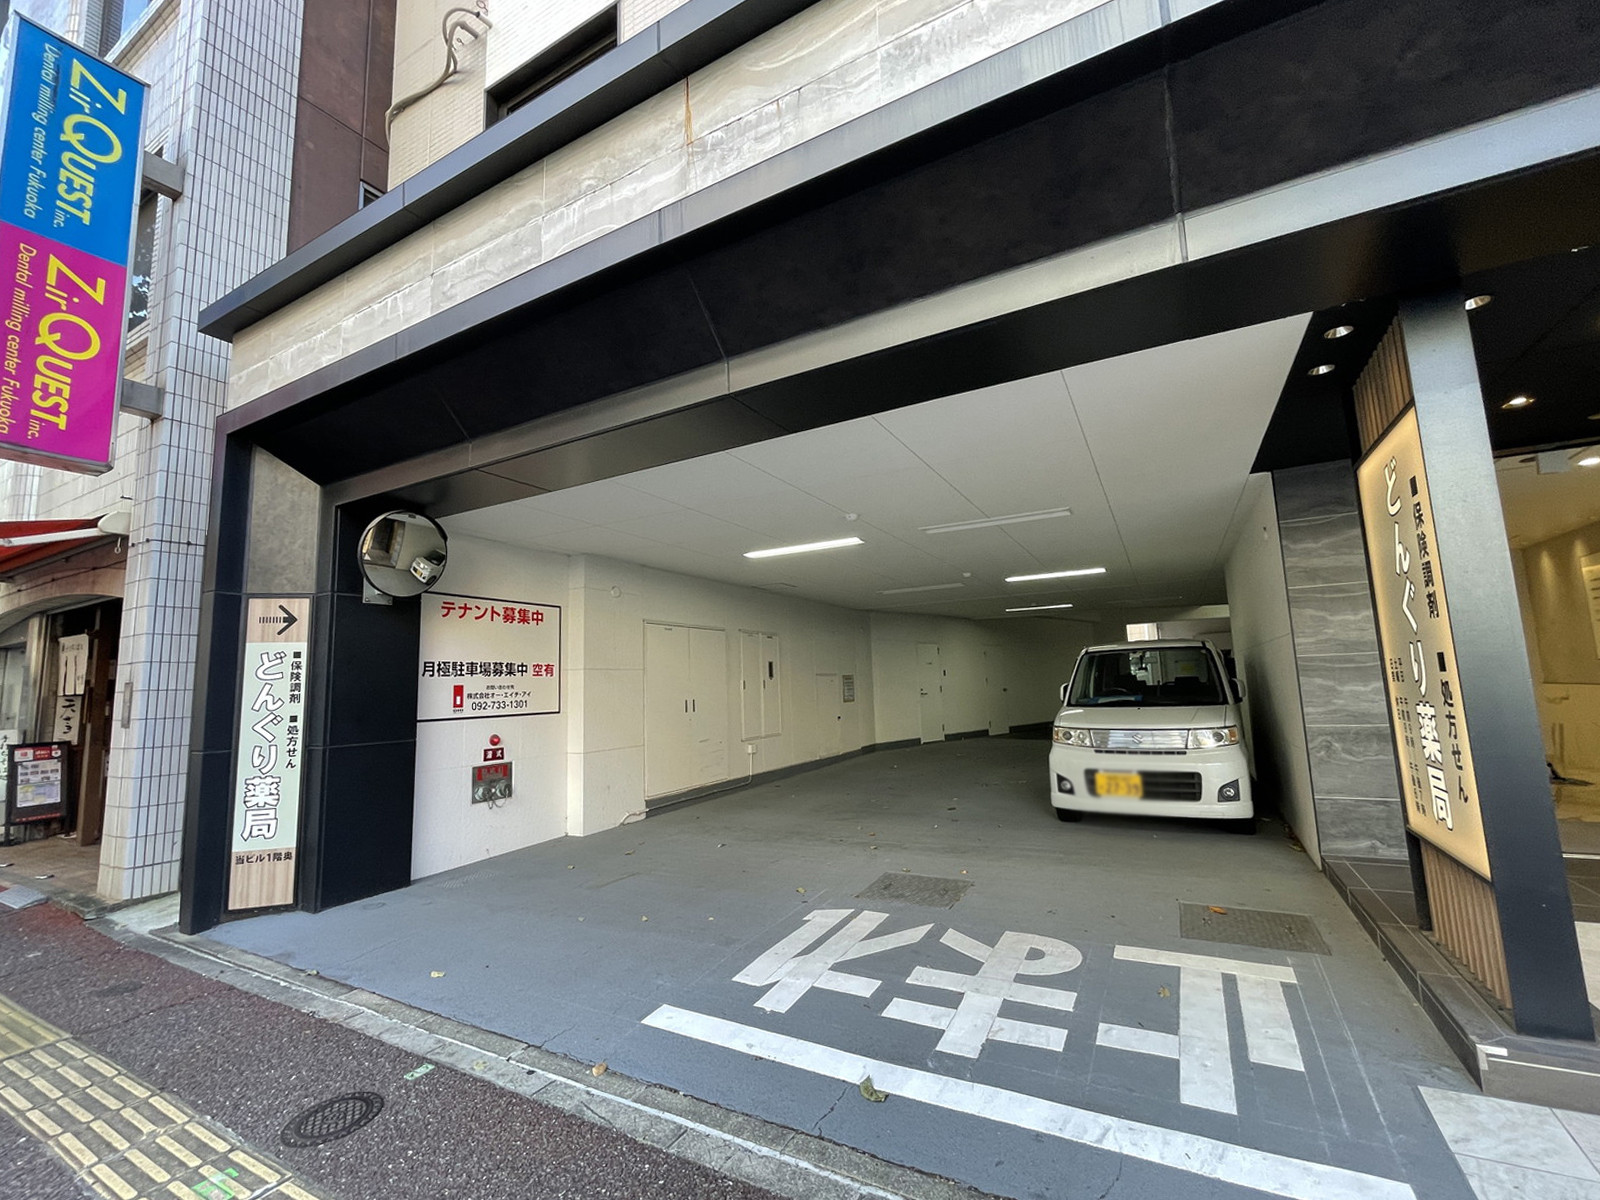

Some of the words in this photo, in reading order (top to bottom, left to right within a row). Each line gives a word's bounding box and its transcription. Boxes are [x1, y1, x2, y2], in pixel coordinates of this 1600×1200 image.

[41, 43, 61, 86] Dental
[31, 83, 55, 126] milling
[31, 126, 48, 165] center
[24, 165, 47, 219] Fukuoka
[53, 208, 71, 228] inc.
[15, 243, 37, 288] Dental
[5, 286, 31, 332] milling
[4, 335, 21, 375] center
[0, 377, 20, 434] Fukuoka
[27, 419, 46, 439] inc.
[441, 601, 544, 626] テナント募集中
[1384, 456, 1454, 832] どんぐり薬局
[1413, 502, 1440, 619] 保険調剤
[1441, 679, 1470, 804] 処方せん
[289, 661, 302, 704] 保険調剤
[422, 661, 528, 678] 月極駐車場募集中
[532, 663, 555, 677] 空有
[471, 700, 528, 711] 092-733-1301
[241, 651, 286, 841] どんぐり薬局
[286, 725, 299, 769] 処方せん
[235, 852, 293, 865] 当ビル1階奥
[733, 908, 1305, 1115] 止まれ
